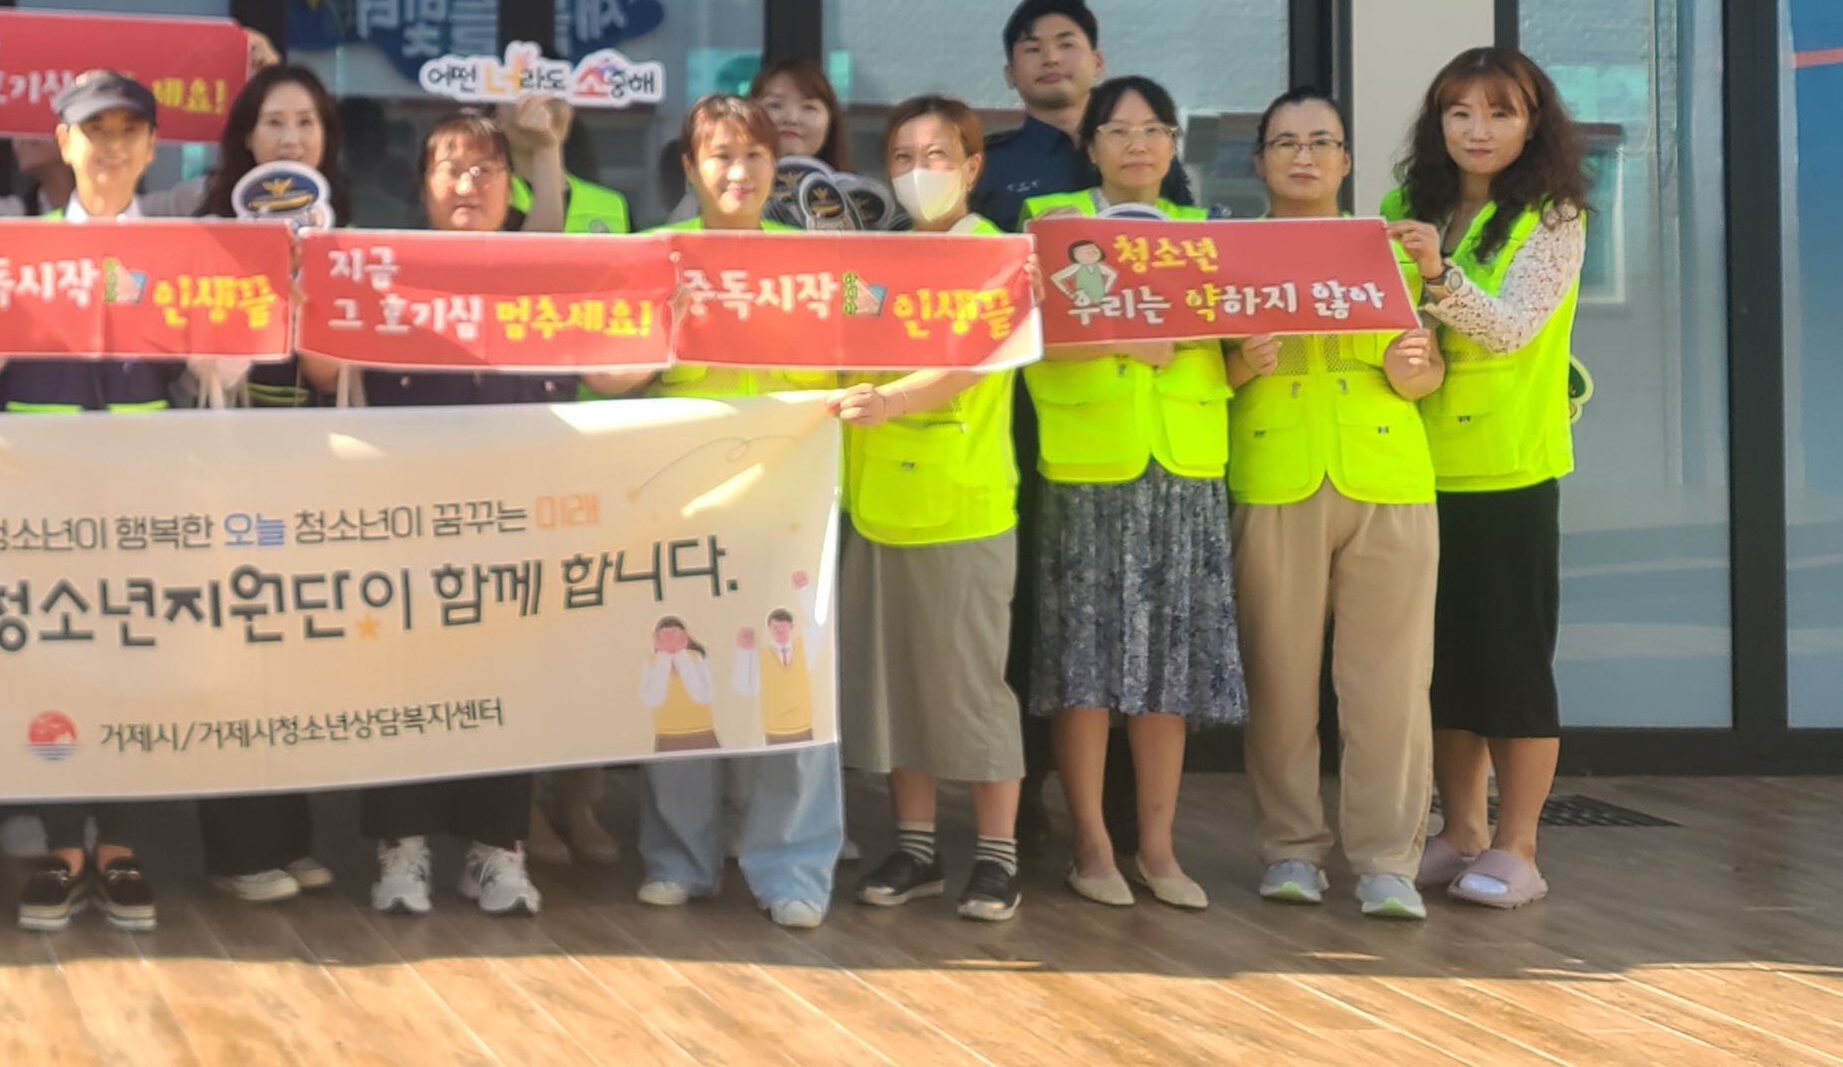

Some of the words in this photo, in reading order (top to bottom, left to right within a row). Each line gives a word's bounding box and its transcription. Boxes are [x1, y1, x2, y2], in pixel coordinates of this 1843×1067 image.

[427, 65, 477, 93] 어떤
[484, 52, 567, 95] 너라도
[573, 63, 655, 99] 소중해
[327, 246, 399, 291] 지금
[1113, 234, 1219, 274] 청소년
[153, 274, 277, 330] 인생끝
[327, 298, 363, 331] 그
[374, 294, 484, 341] 호기심
[495, 295, 653, 342] 멈추세요!
[683, 269, 838, 320] 중독시작
[893, 288, 1015, 340] 인생끝
[1068, 285, 1171, 326] 우리는
[1185, 282, 1298, 323] 약하지
[1311, 280, 1385, 320] 않아
[115, 514, 215, 551] 행복한
[224, 512, 287, 547] 오늘
[294, 505, 422, 546] 청소년이
[431, 500, 528, 538] 꿈꾸는
[534, 492, 600, 531] 미래
[430, 559, 543, 628] 함께
[560, 534, 739, 611] 합니다.
